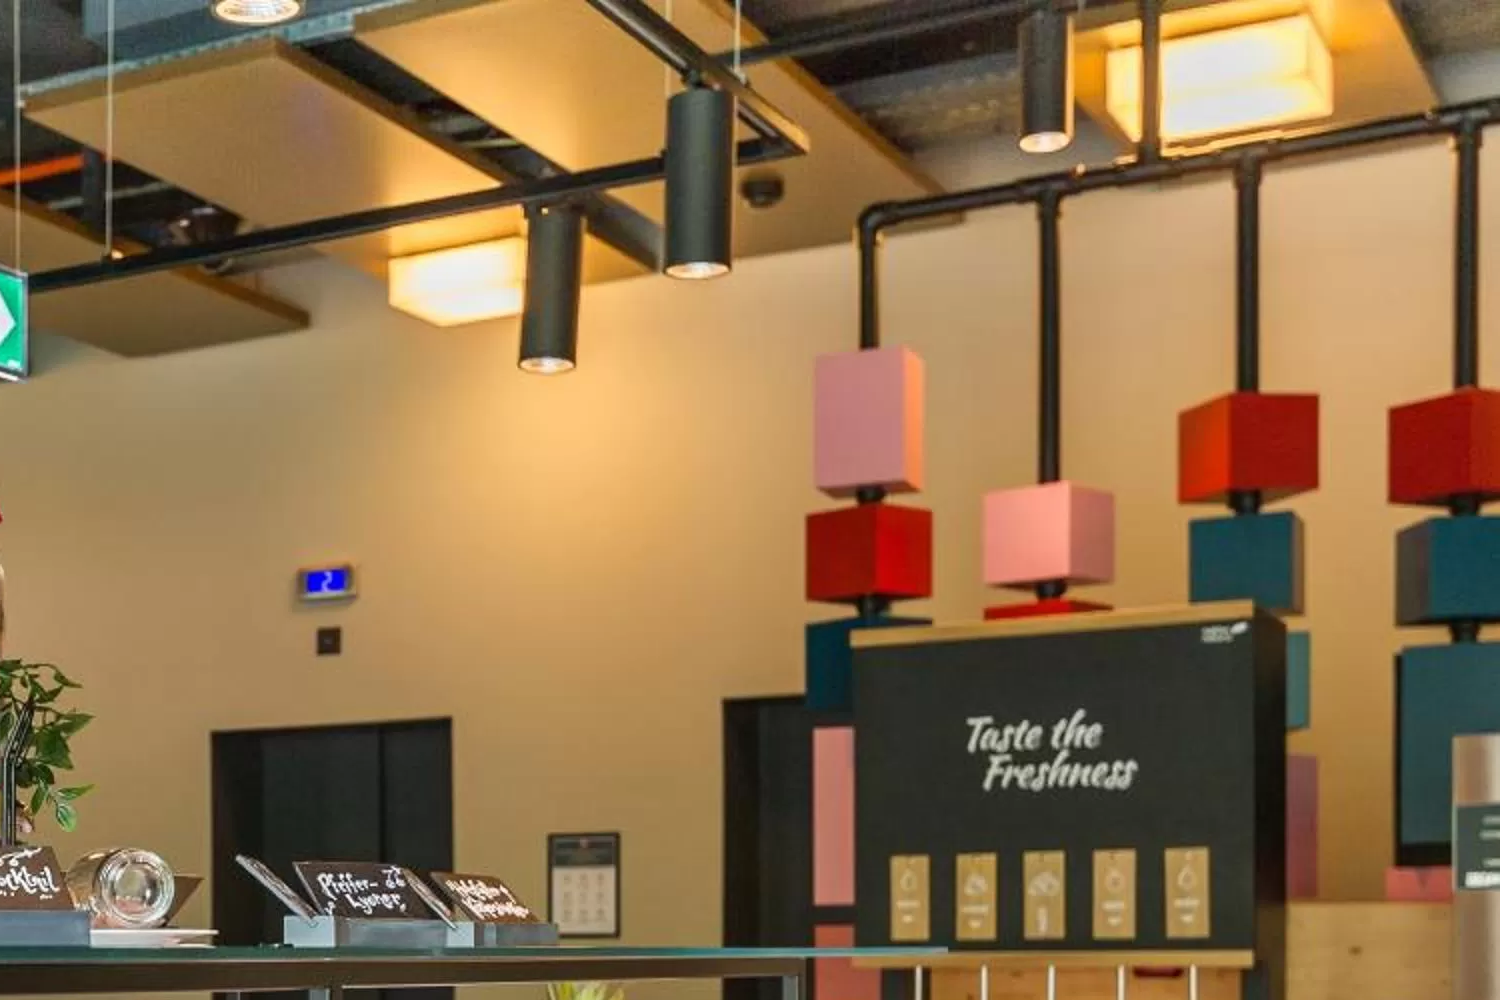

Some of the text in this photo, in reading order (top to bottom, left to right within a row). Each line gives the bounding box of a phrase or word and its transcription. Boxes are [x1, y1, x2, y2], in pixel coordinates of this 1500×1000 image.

[966, 708, 1103, 754] Taste the
[983, 749, 1138, 792] Freshness
